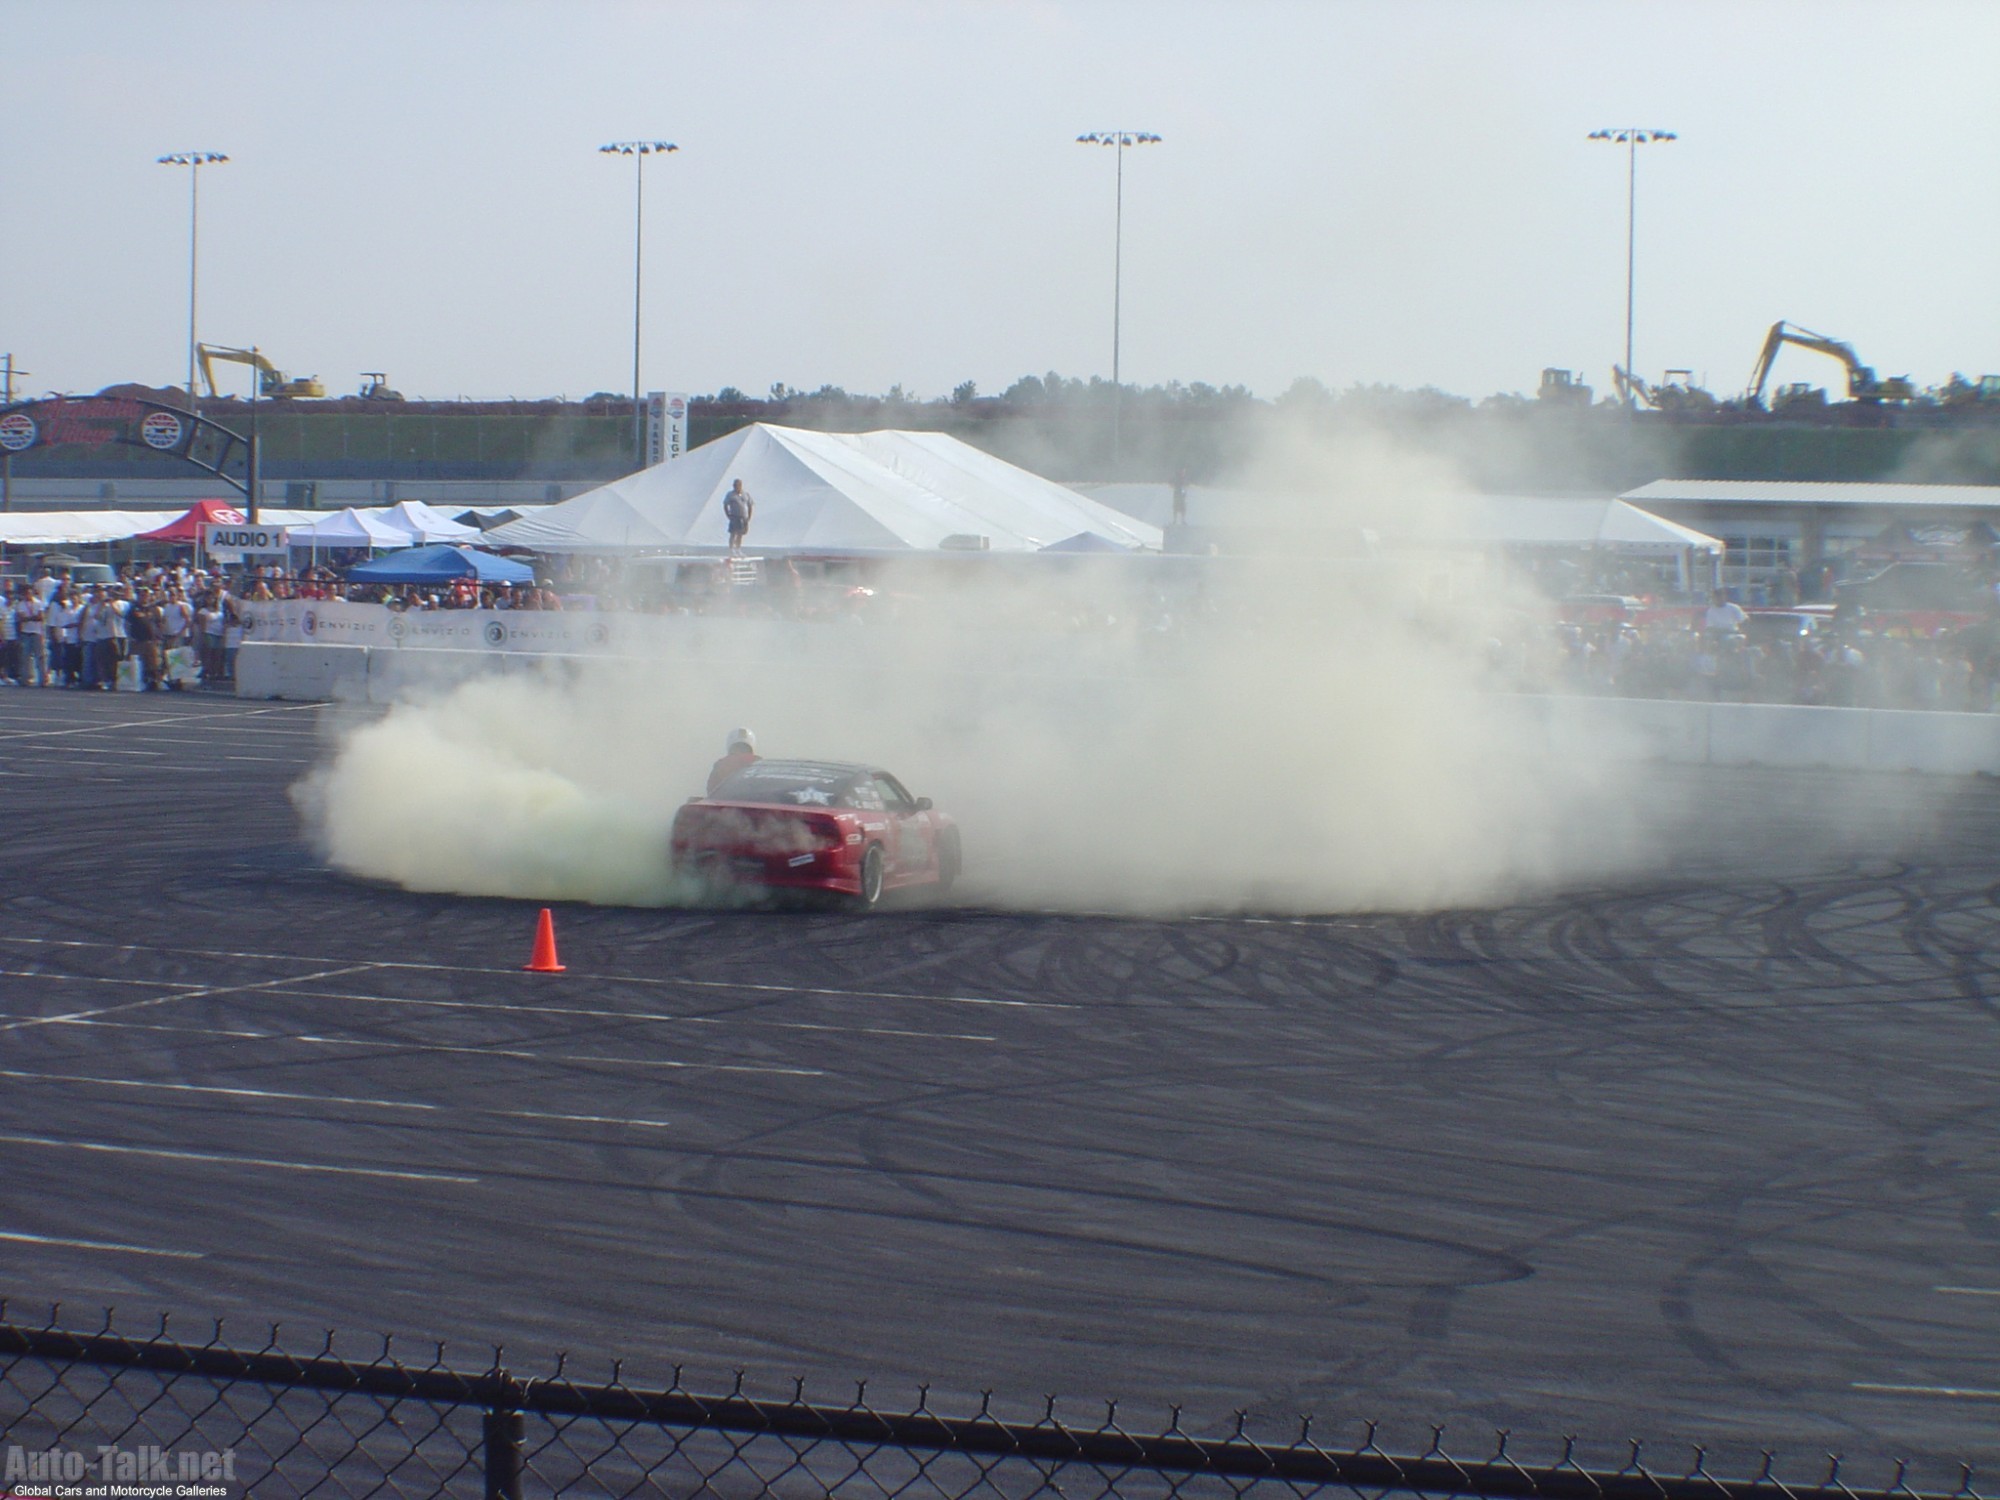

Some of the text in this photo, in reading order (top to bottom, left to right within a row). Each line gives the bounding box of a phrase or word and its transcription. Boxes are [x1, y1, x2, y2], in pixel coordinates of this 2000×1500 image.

[213, 531, 280, 548] AUDIO 1
[318, 618, 376, 632] ENVIZIO
